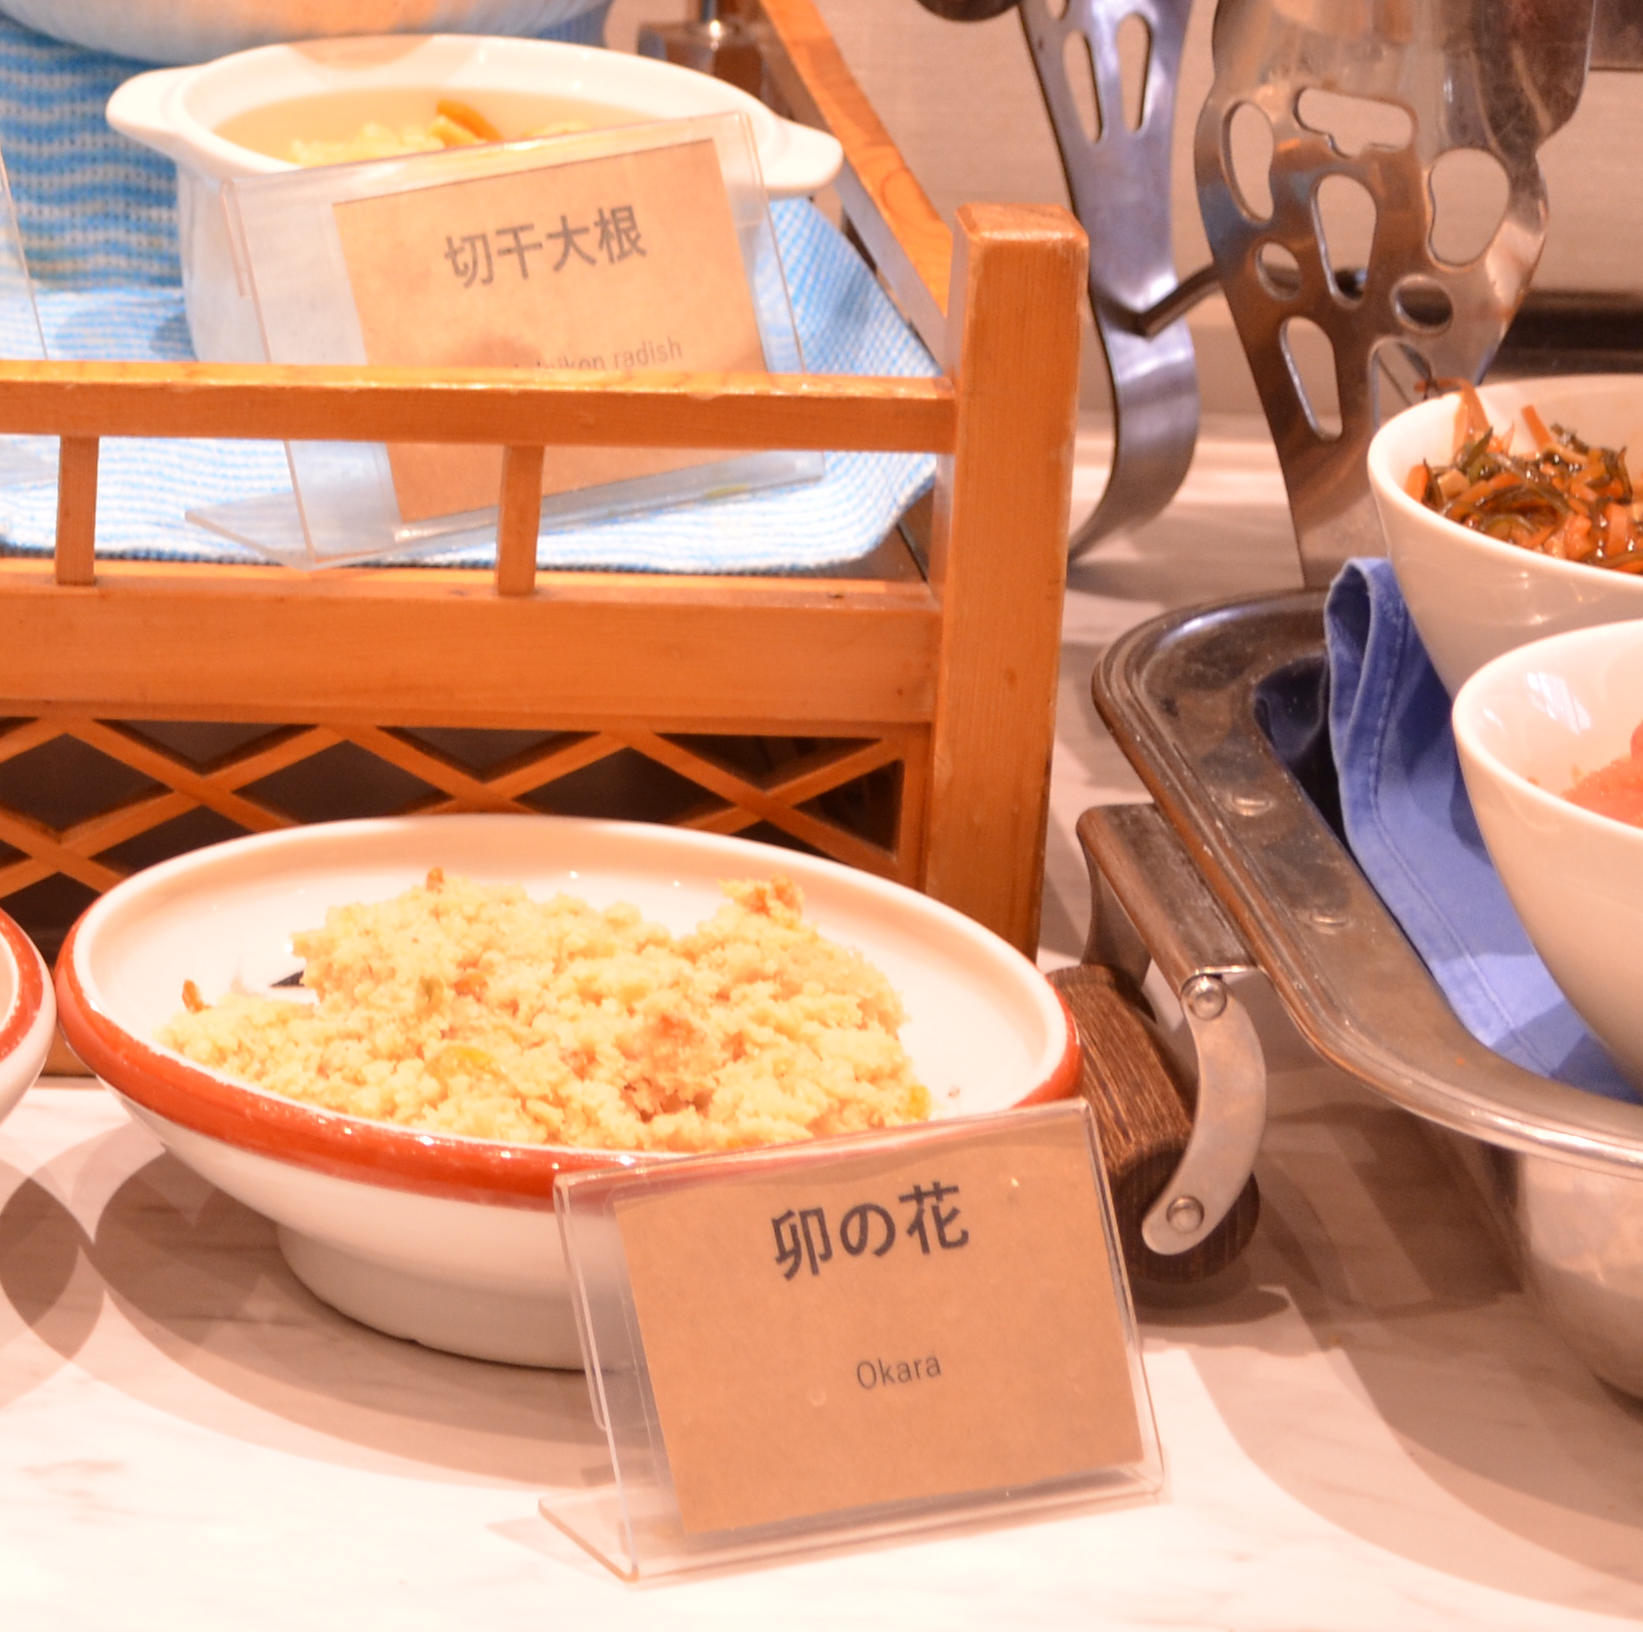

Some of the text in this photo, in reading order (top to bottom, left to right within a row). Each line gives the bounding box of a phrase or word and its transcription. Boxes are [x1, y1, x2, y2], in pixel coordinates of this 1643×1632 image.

[444, 205, 647, 289] 切干大根
[770, 1180, 970, 1282] 卯の花
[855, 1355, 942, 1390] Okara
